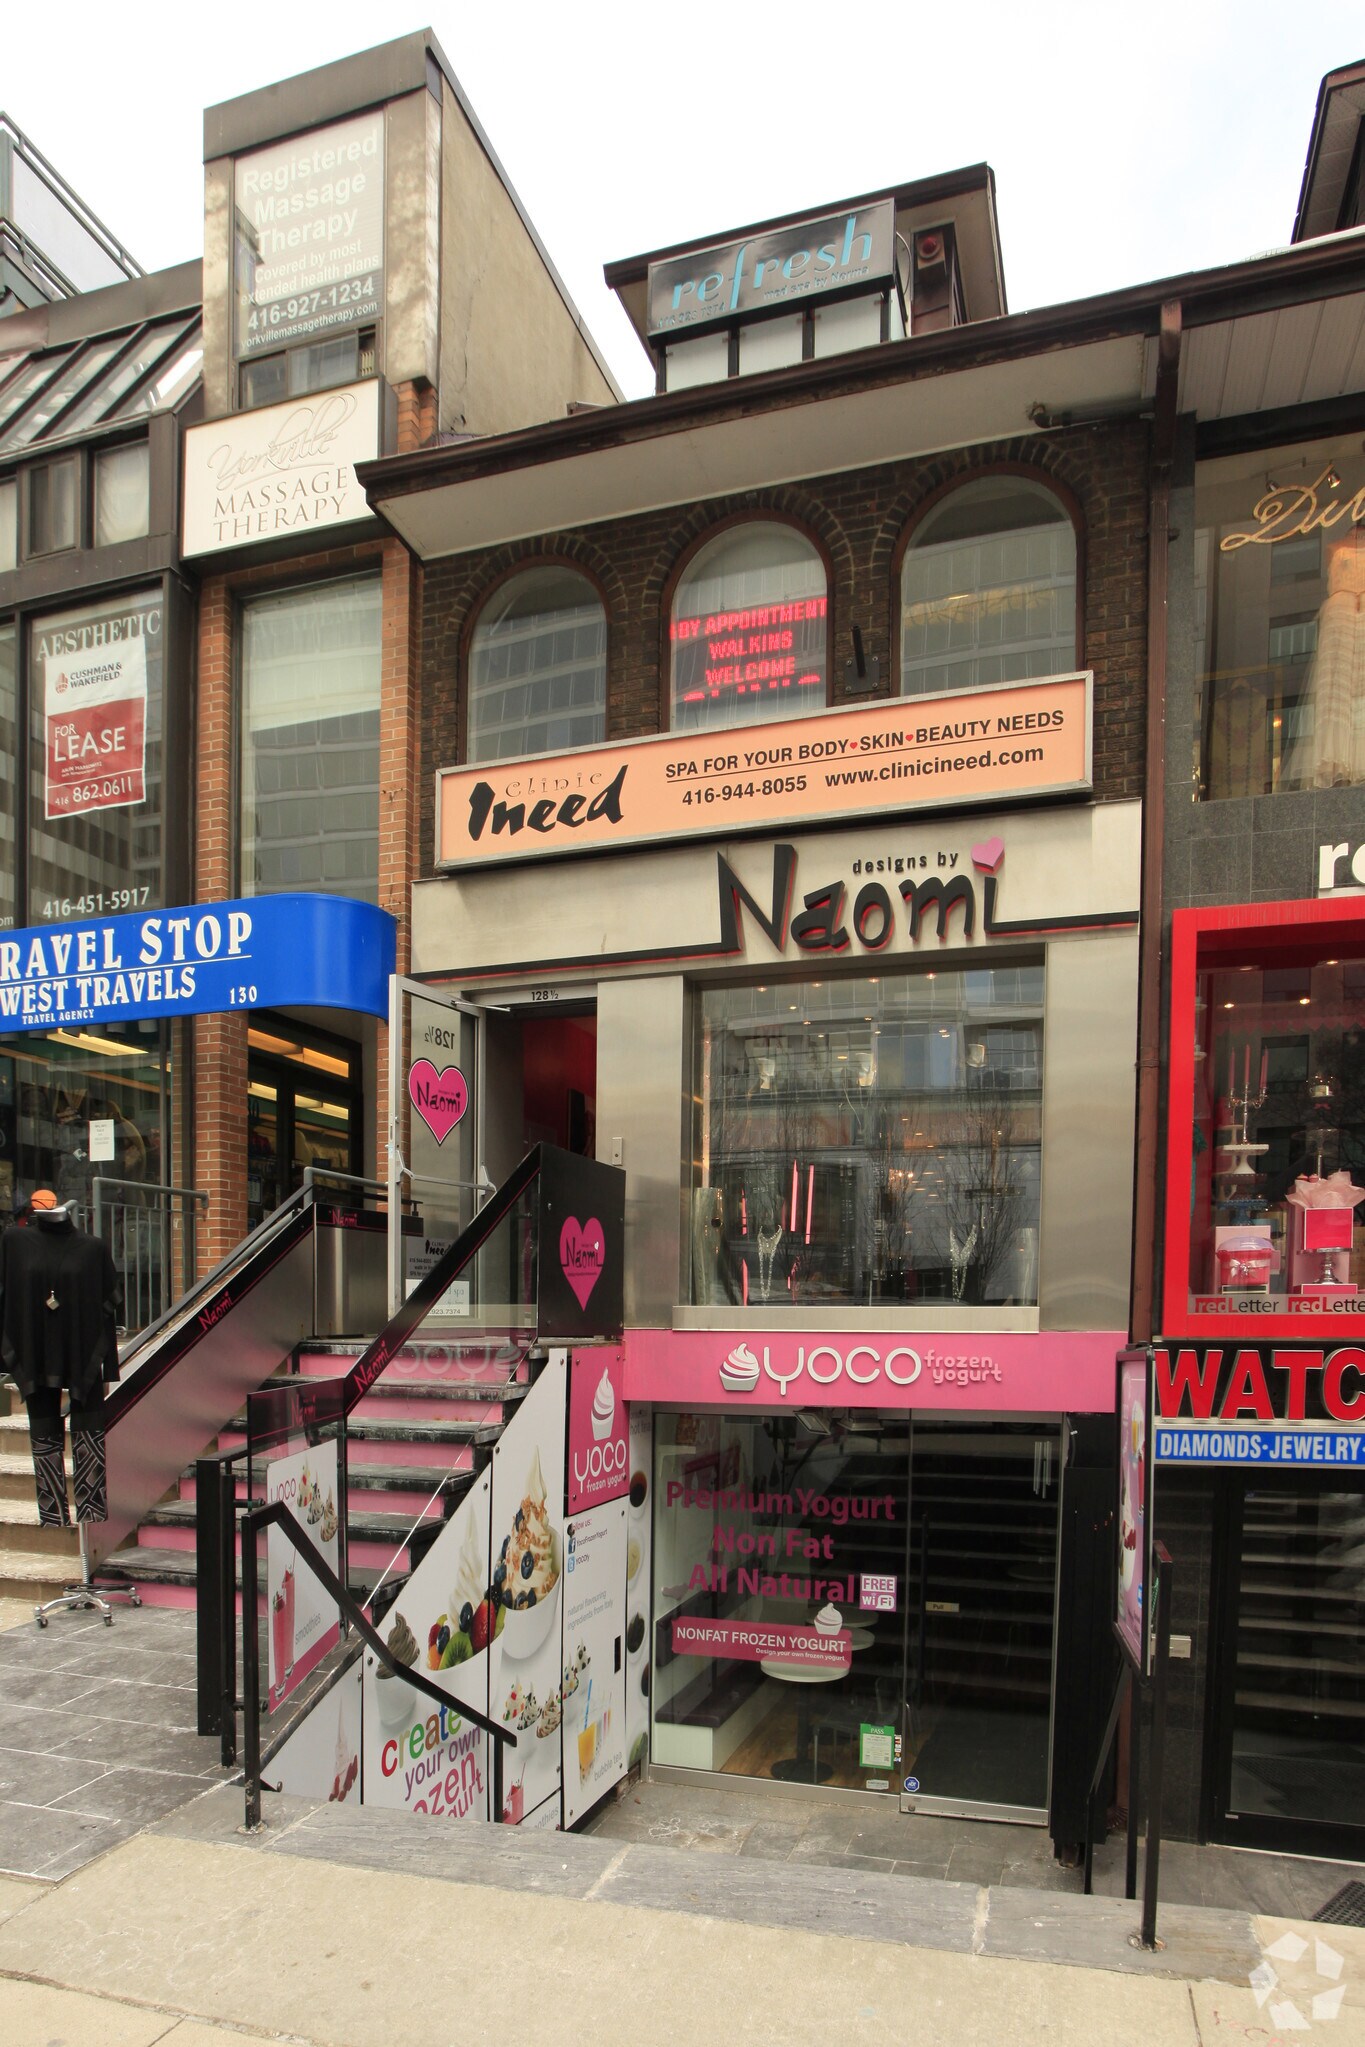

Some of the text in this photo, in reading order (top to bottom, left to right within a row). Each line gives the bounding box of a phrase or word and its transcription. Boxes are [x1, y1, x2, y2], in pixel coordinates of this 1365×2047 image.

[242, 130, 378, 197] Registered
[254, 170, 366, 226] Massage
[255, 208, 358, 257] Therapy
[240, 254, 379, 306] extended health plans
[254, 239, 362, 284] Covered by most
[671, 217, 873, 311] refresh
[831, 266, 869, 283] Norma
[247, 276, 374, 331] 416-927-1234
[240, 301, 378, 350] yorkvillemassagetherapy.com
[207, 393, 358, 491] Yorkville
[214, 466, 349, 518] MASSAGE
[213, 493, 347, 542] THERAPY
[36, 609, 161, 662] AESTHETIC
[678, 597, 827, 640] BY APPOINTMENT
[70, 661, 123, 681] CUSHMAN &
[70, 671, 120, 688] WAKEFIELD
[705, 656, 796, 686] WELCOME
[54, 724, 76, 739] FOR
[54, 727, 126, 762] LEASE
[665, 709, 1065, 778] SPA FOR YOUR BODY SKIN BEAUTY NEEDS
[54, 776, 132, 806] 416 862.0611
[505, 771, 602, 798] Clinic
[682, 747, 1044, 807] 416-944-8055 www.clinicineed.com
[468, 764, 629, 841] Ineed
[852, 850, 960, 875] designs by
[42, 887, 149, 919] 416-451-5917
[717, 839, 1004, 953] Naomi
[139, 912, 253, 964] STOP
[0, 966, 196, 1016] WEST TRAVELS
[230, 986, 257, 1004] 130
[22, 1009, 94, 1025] TRAVEL AGENCY
[416, 1081, 461, 1113] Naomi
[565, 1236, 599, 1269] Naomi
[198, 1291, 234, 1332] Naomi
[1195, 1296, 1279, 1313] redLetter
[354, 1341, 391, 1394] Naomi
[764, 1346, 993, 1396] YOCO frozen
[932, 1363, 1002, 1386] yogurt
[574, 1439, 627, 1494] YOCO
[1160, 1433, 1359, 1460] DIAMONDS JEWELRY
[586, 1470, 626, 1493] frozen yogurt
[666, 1481, 896, 1525] Premium Yogurt
[570, 1520, 584, 1532] ollow
[713, 1524, 834, 1560] Non Fat
[688, 1564, 854, 1603] All Natural
[863, 1578, 894, 1592] FREE
[677, 1627, 846, 1653] NONFAT FROZEN YOGURT
[756, 1648, 776, 1657] Design
[777, 1651, 791, 1659] your
[805, 1652, 824, 1660] frozen
[825, 1653, 845, 1662] yogurt
[381, 1702, 462, 1778] create
[405, 1725, 481, 1801] your own
